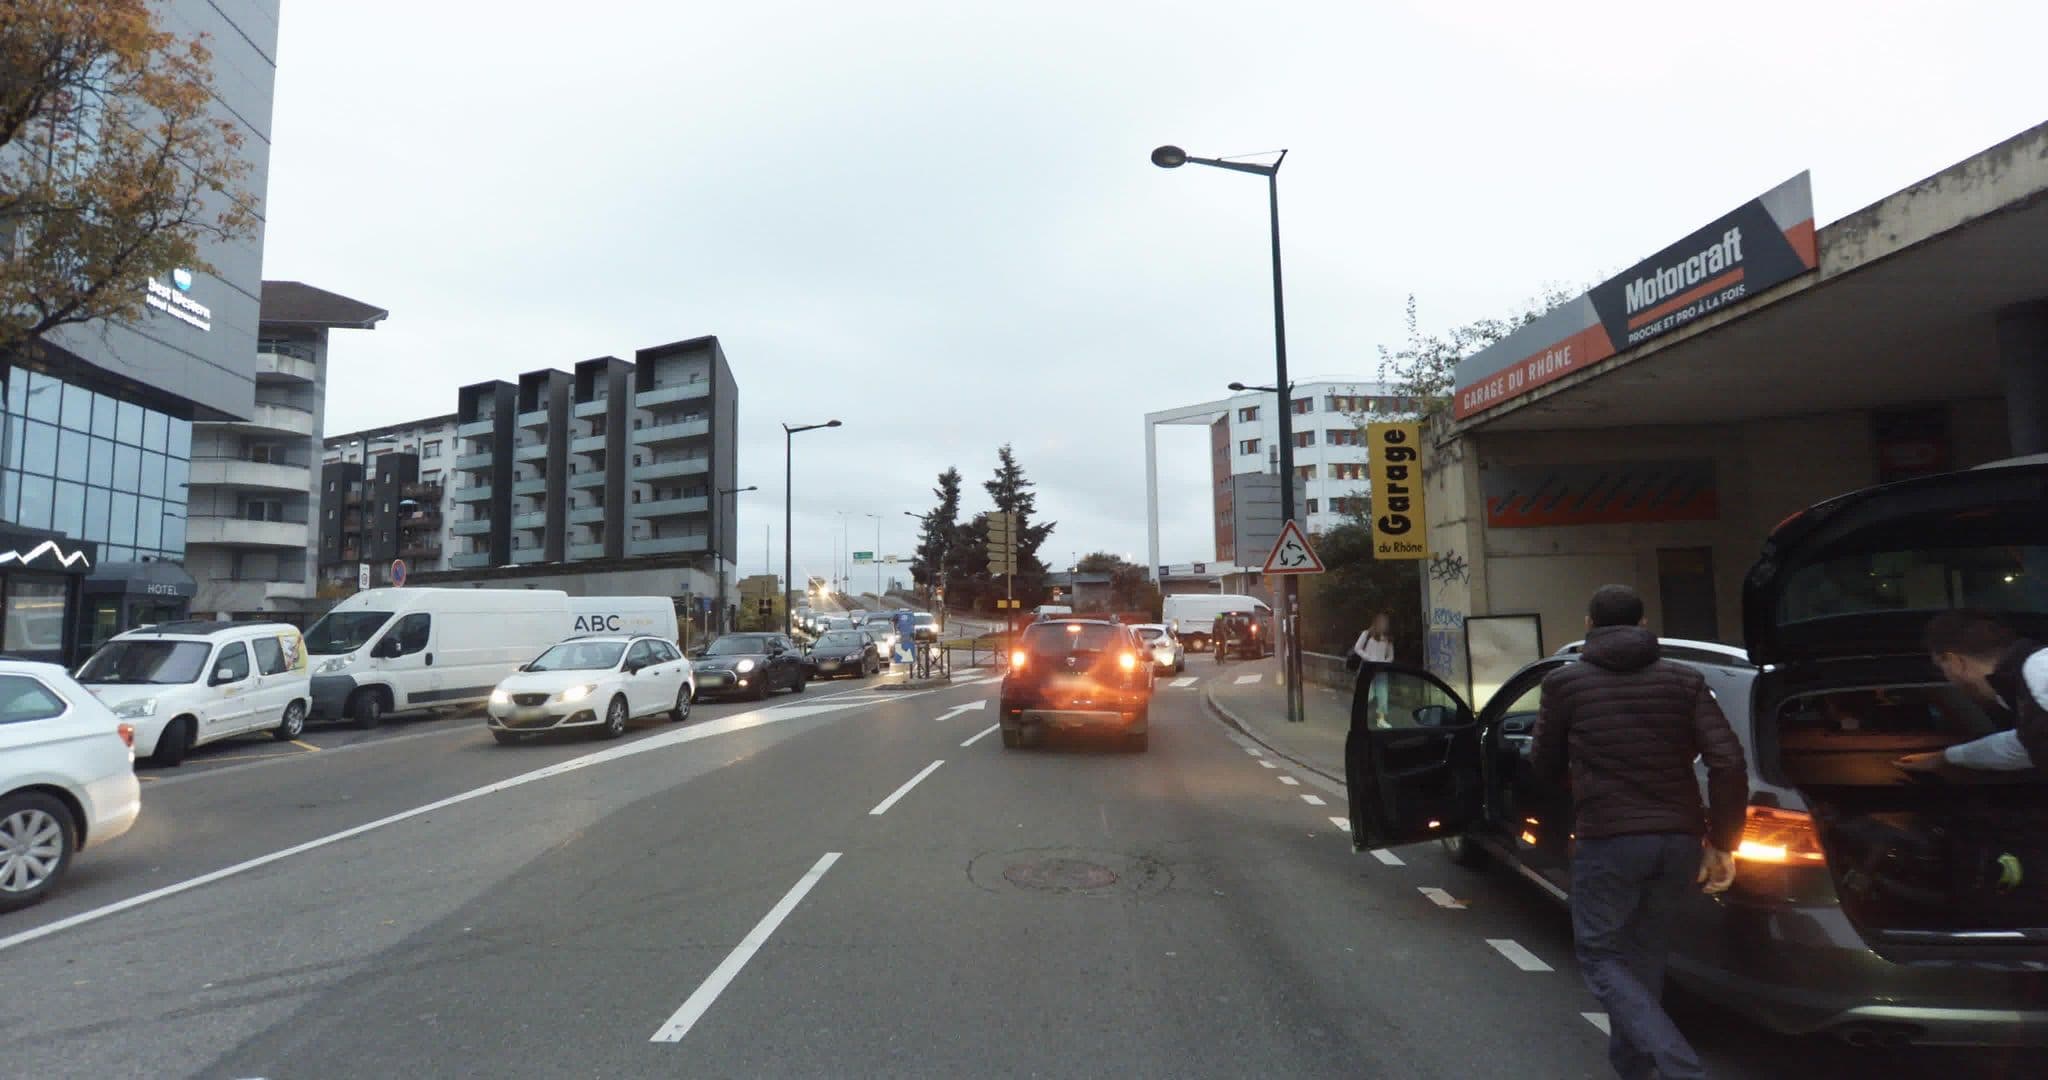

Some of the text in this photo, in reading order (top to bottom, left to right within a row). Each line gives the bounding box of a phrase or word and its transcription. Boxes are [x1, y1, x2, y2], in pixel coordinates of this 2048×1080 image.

[148, 276, 211, 319] Best Western
[1624, 226, 1744, 315] Motorcraft
[1628, 322, 1663, 344] PROCHE
[1663, 315, 1675, 329] ET
[1676, 306, 1696, 325] PRO
[1706, 297, 1720, 311] LA
[1721, 284, 1746, 305] FOIS
[1463, 345, 1572, 410] GARAGE DU RHÔNE
[1378, 429, 1417, 535] Garage
[1379, 541, 1423, 553] du Rhône
[574, 614, 620, 632] ABC
